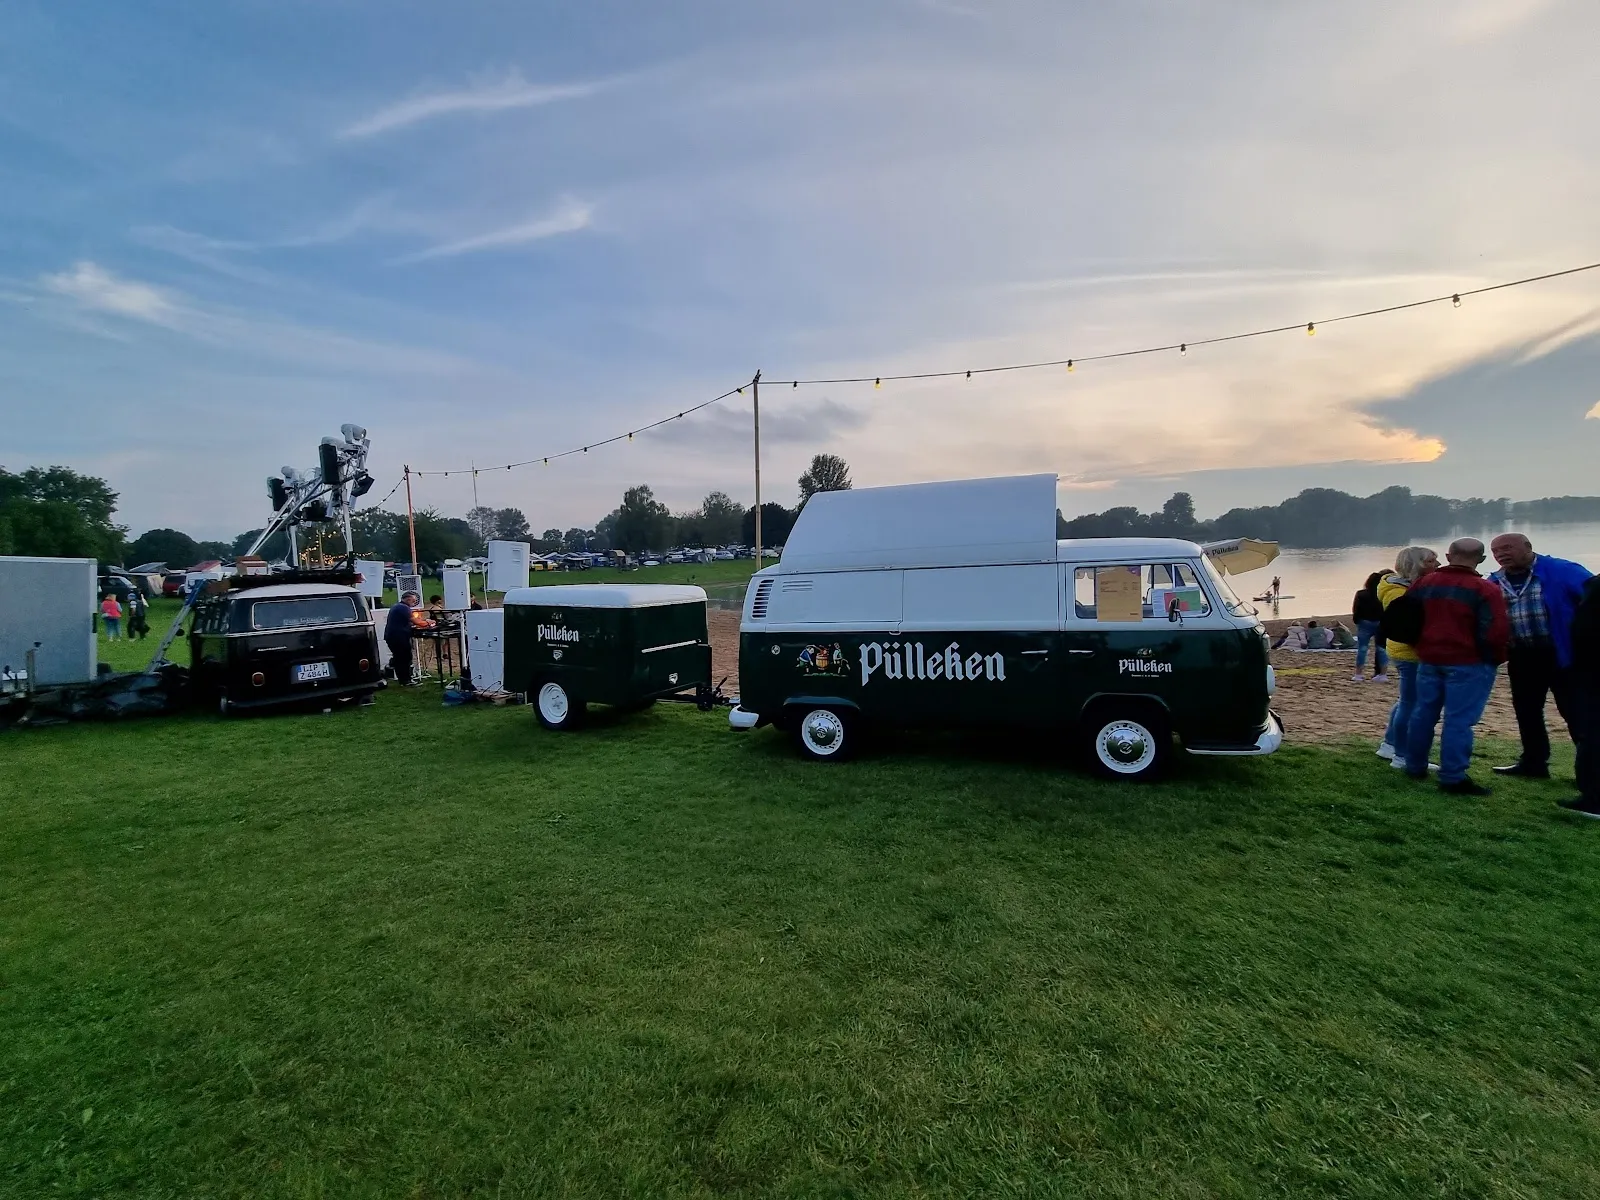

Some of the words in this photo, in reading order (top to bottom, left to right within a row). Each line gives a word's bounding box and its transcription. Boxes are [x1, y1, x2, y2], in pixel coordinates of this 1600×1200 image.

[537, 624, 580, 643] Pülleken
[858, 641, 1006, 687] Pülleken
[1118, 658, 1172, 675] Pülleken
